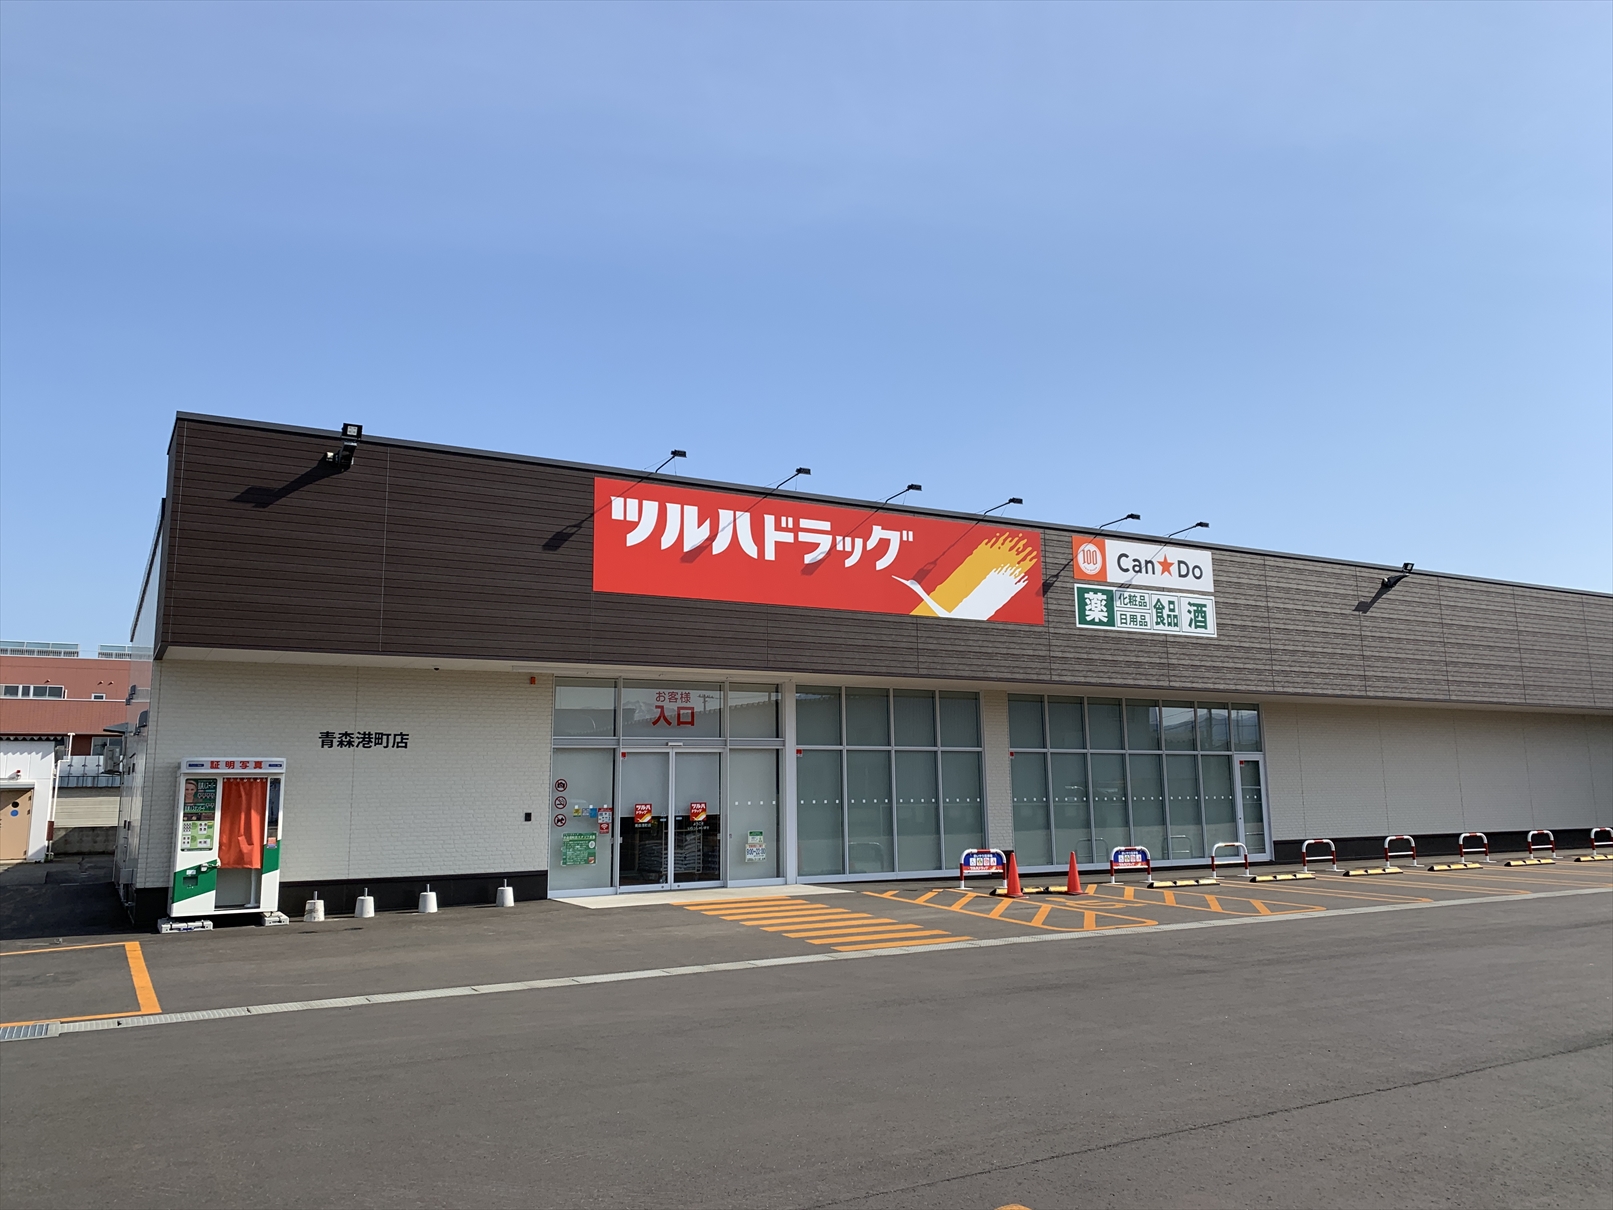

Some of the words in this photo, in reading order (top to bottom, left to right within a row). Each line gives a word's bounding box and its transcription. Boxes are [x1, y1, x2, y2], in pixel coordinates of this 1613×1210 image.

[610, 496, 914, 571] ツルハドラッグ
[1081, 549, 1098, 566] 100
[1084, 592, 1108, 622] 薬
[1118, 593, 1148, 607] 化粧品
[1119, 613, 1148, 627] 日用品
[1153, 598, 1179, 628] 食品
[1187, 601, 1208, 630] 酒
[655, 691, 691, 703] お客様
[652, 705, 695, 726] 入口
[318, 731, 410, 749] 青森港町店
[210, 761, 263, 770] 証明写真
